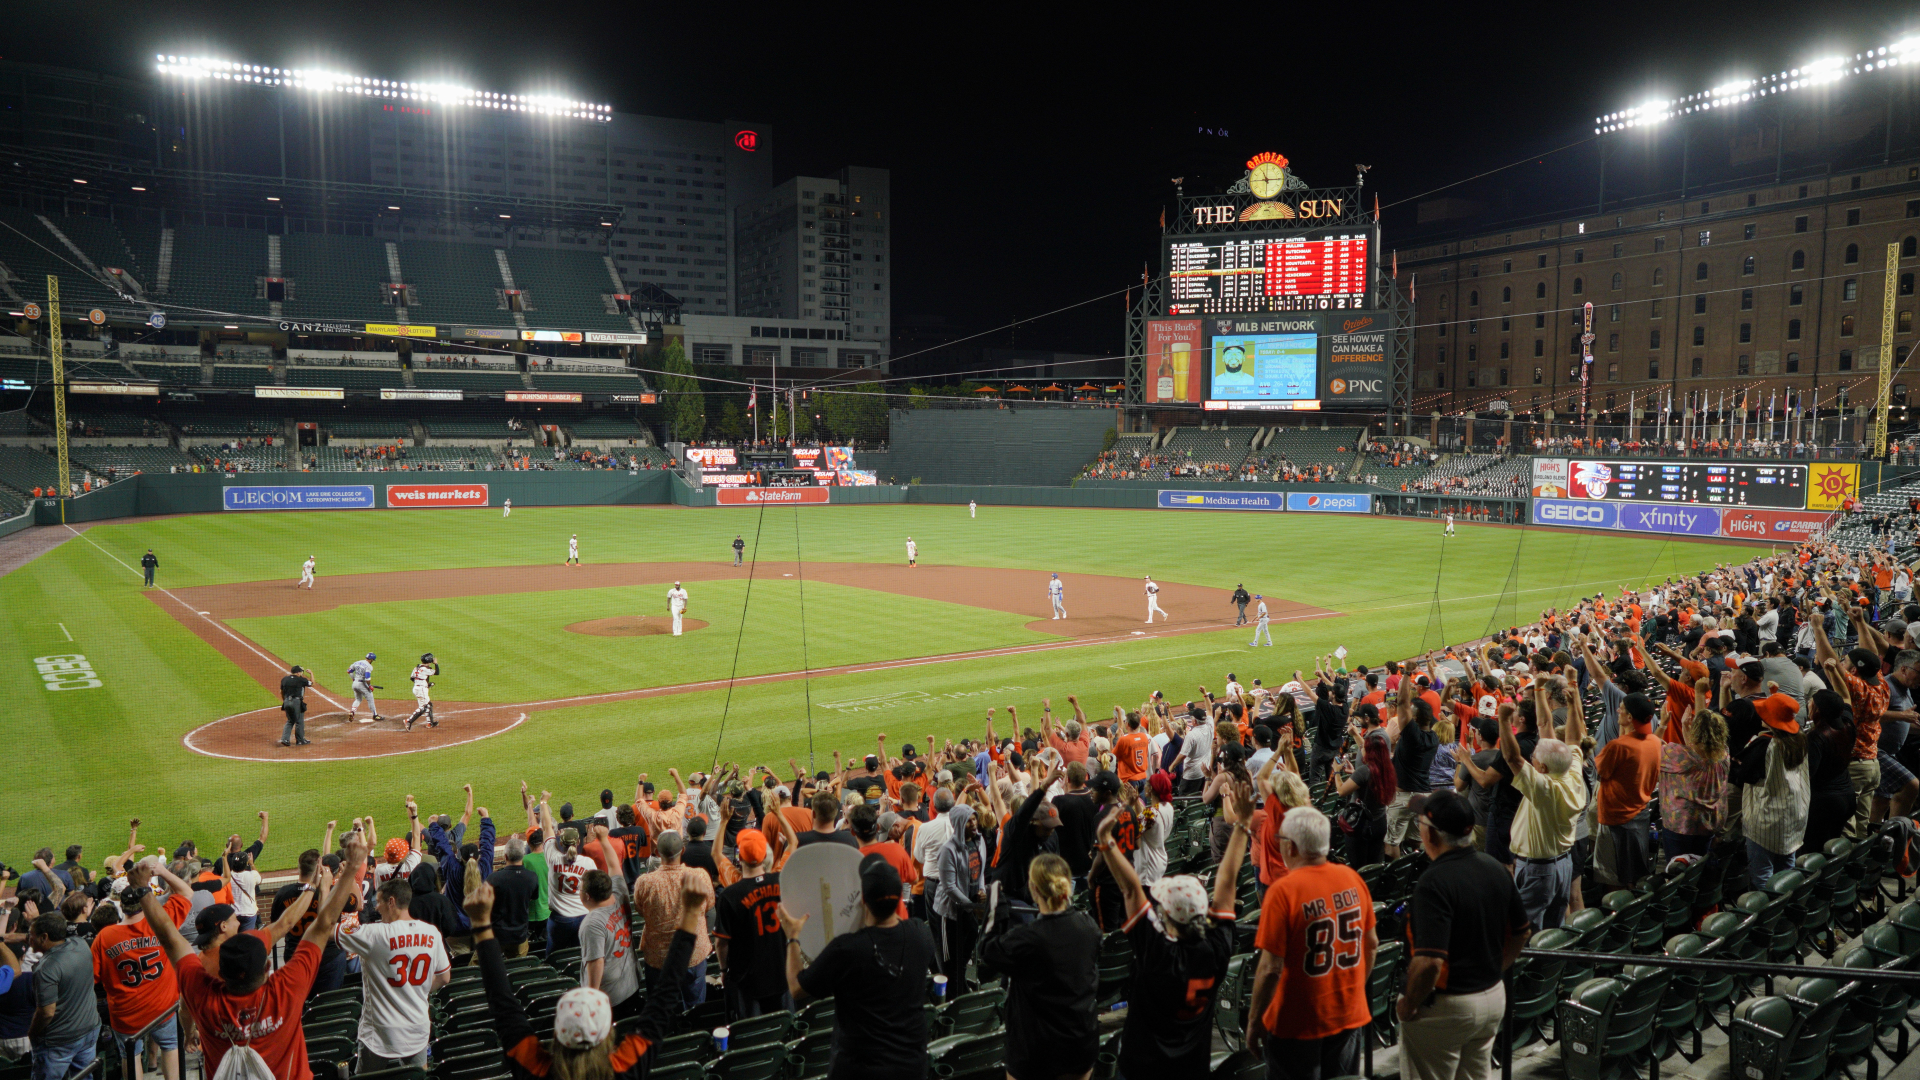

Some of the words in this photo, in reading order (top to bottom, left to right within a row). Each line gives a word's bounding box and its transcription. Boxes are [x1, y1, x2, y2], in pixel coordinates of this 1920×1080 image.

[1246, 152, 1289, 170] ORIOLES
[1193, 206, 1235, 225] THE
[1299, 199, 1343, 218] SUN
[1320, 300, 1328, 309] 0
[1337, 299, 1345, 308] 2
[1354, 299, 1362, 308] 2
[26, 308, 39, 316] 33
[95, 313, 101, 321] 8
[152, 317, 163, 325] 42
[280, 322, 322, 332] GANZ
[1175, 323, 1196, 331] Bud's
[1236, 323, 1258, 332] MLB
[1261, 321, 1315, 331] NETWORK
[1343, 316, 1373, 331] Orioles
[1332, 354, 1384, 362] DIFFERENCE
[430, 389, 461, 398] UNION
[1348, 380, 1382, 393] PNC
[1540, 463, 1560, 473] HIGH'S
[395, 490, 425, 500] weis
[427, 489, 480, 500] markets
[1205, 497, 1239, 505] MedStar
[1241, 497, 1270, 506] Health
[1324, 497, 1356, 509] pepsi
[1541, 504, 1604, 522] GEICO
[1639, 508, 1697, 531] xfinity
[1730, 520, 1766, 534] HIGH'S
[34, 654, 103, 691] GEICO
[1135, 750, 1144, 766] 5
[557, 874, 579, 893] 13
[1303, 898, 1332, 920] MR.
[1332, 888, 1360, 911] BOH
[755, 901, 780, 936] 13
[390, 934, 434, 951] ABRAMS
[1303, 906, 1363, 977] 85
[117, 950, 164, 987] 35
[387, 953, 431, 988] 30
[1180, 976, 1215, 1017] 5
